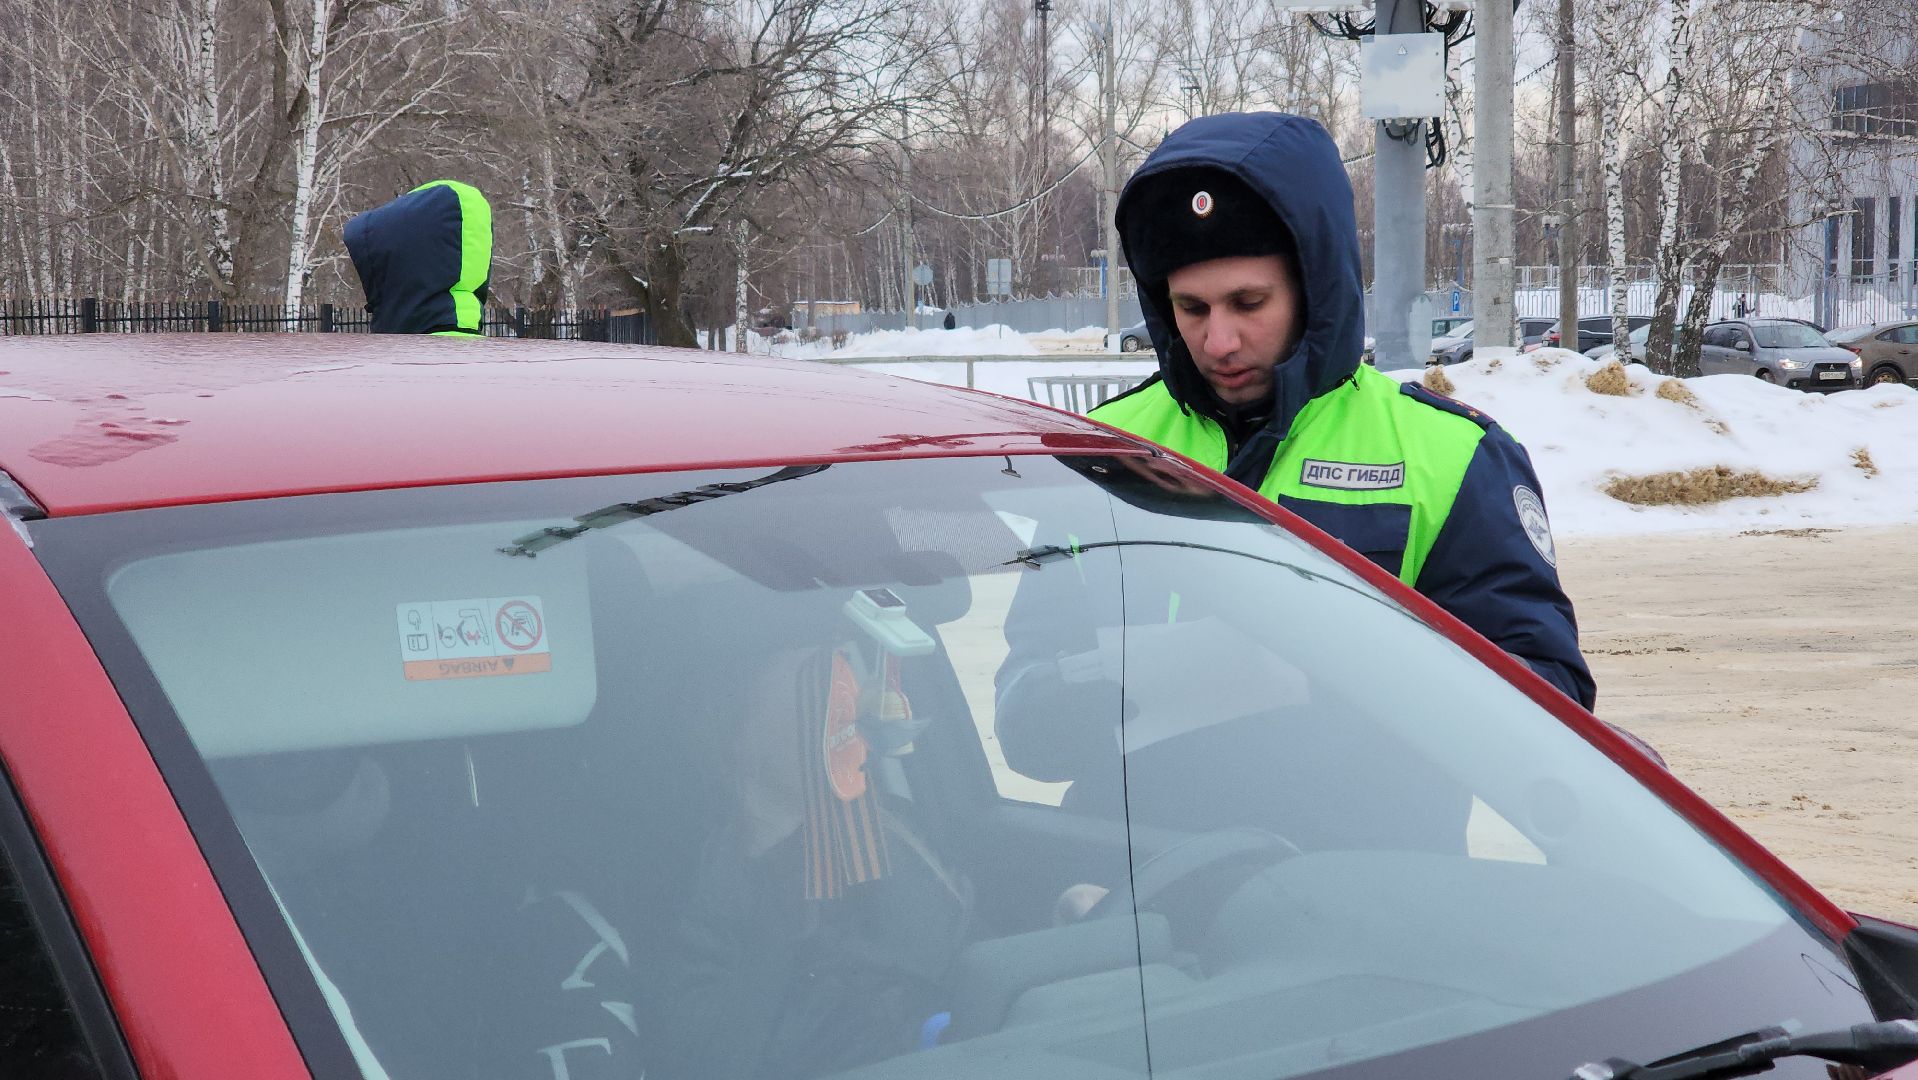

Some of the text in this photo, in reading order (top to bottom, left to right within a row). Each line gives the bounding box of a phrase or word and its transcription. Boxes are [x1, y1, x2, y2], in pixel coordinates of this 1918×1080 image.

[1453, 292, 1459, 310] P
[1307, 465, 1400, 484] ДПС ГИБДД
[440, 659, 497, 675] AIRBAG
